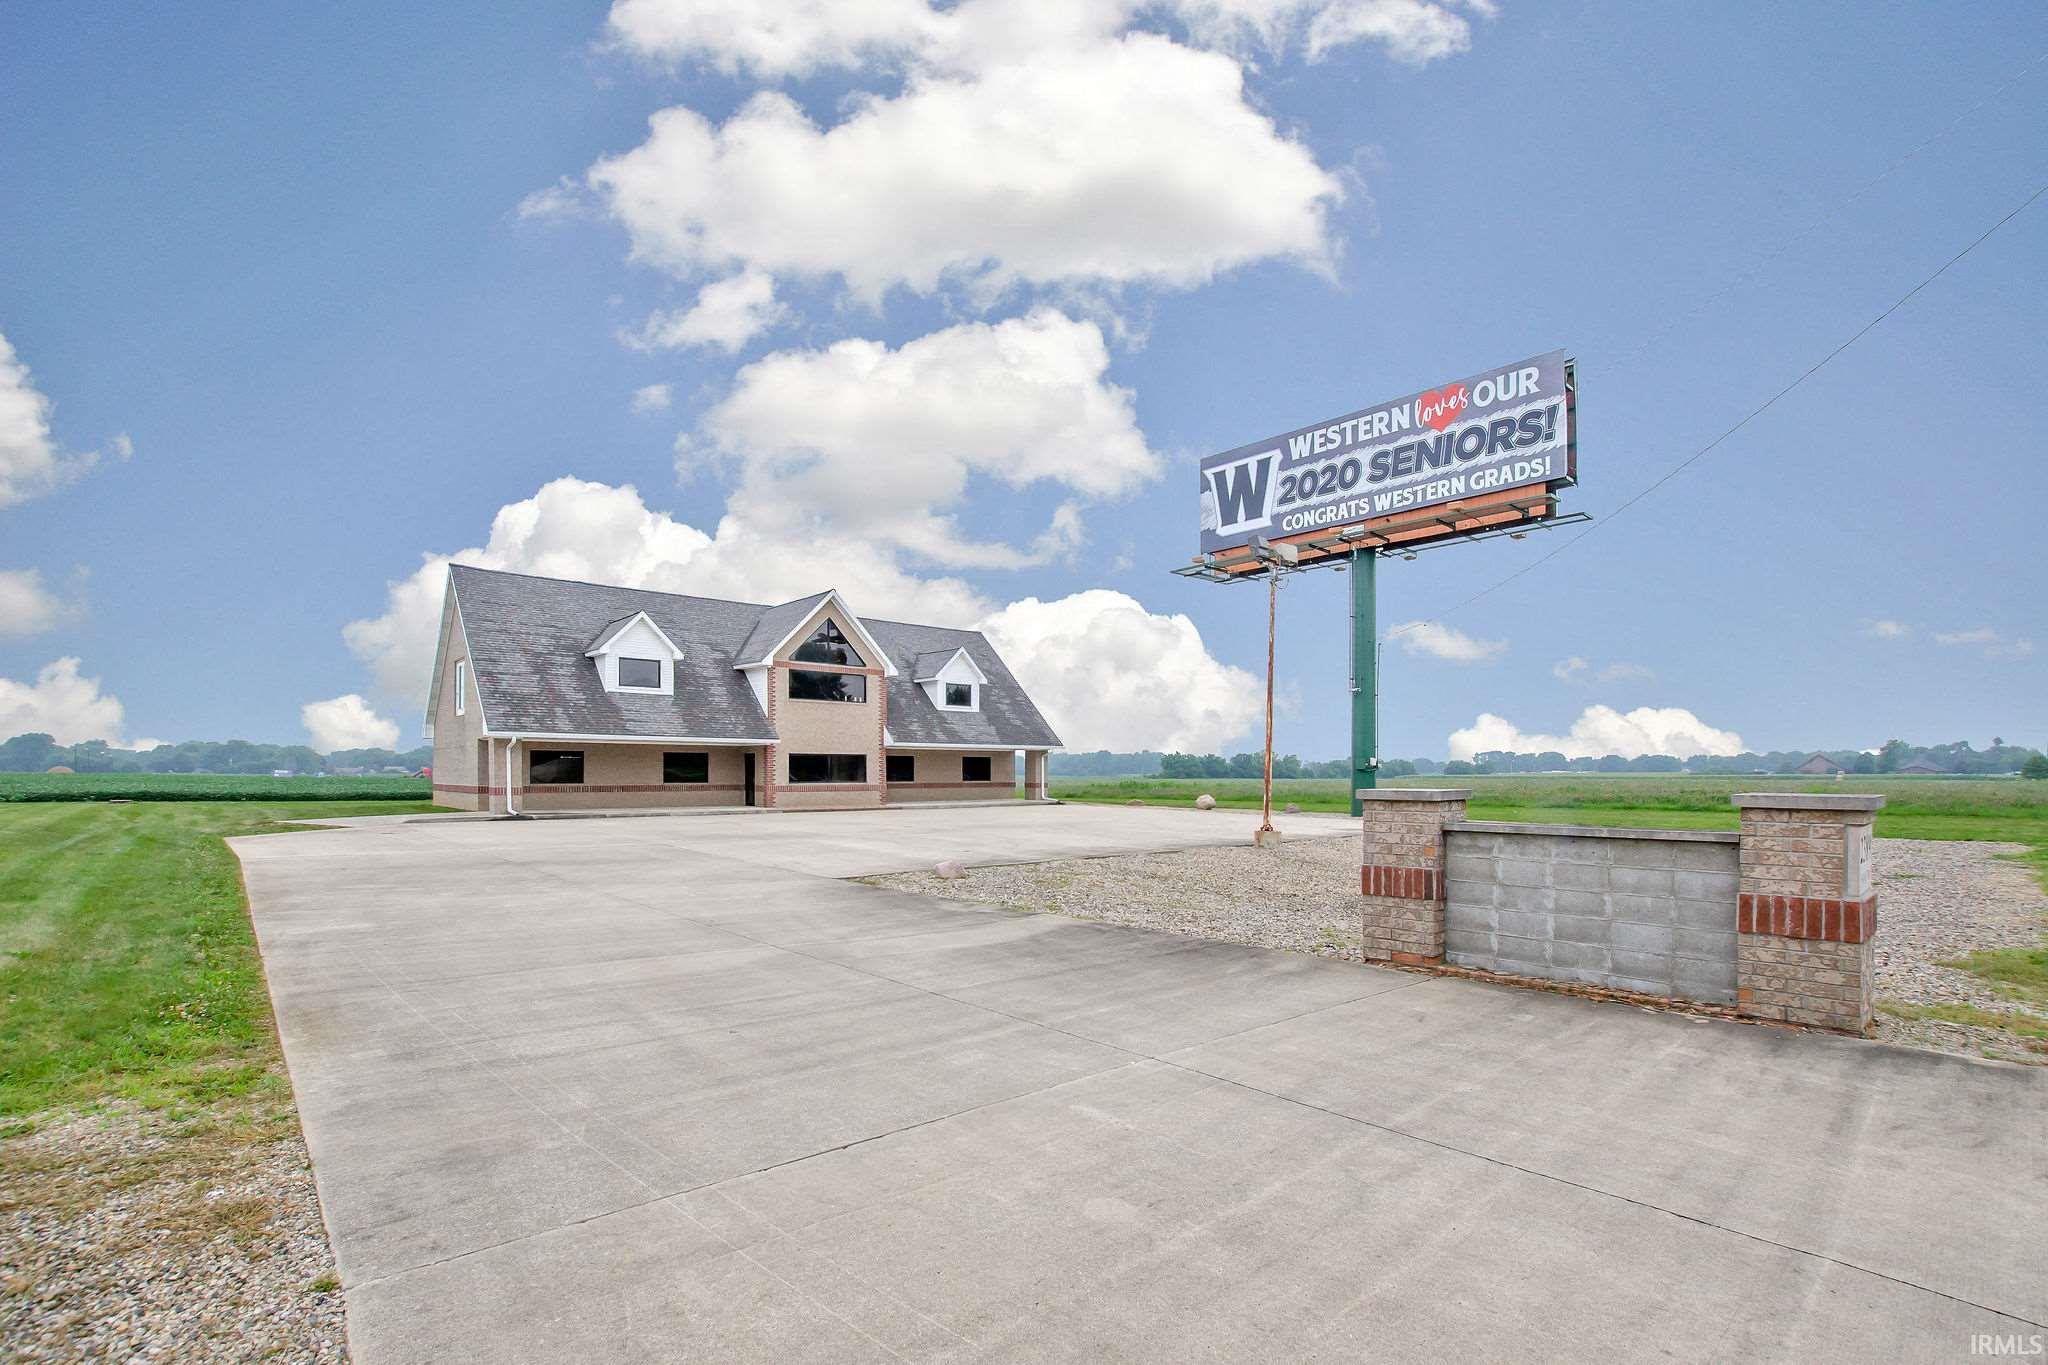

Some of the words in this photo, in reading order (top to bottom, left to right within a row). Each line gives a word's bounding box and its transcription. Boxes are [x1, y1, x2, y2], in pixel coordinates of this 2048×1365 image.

[1277, 458, 1362, 507] 2020
[1368, 404, 1560, 484] SENIORS!
[1288, 404, 1411, 461] WESTERN
[1414, 387, 1471, 429] loves
[1472, 366, 1541, 407] OUR
[1210, 455, 1276, 530] W
[1282, 497, 1370, 531] CONGRATS
[1374, 475, 1466, 511] WESTERN
[1469, 456, 1551, 490] GRADS!
